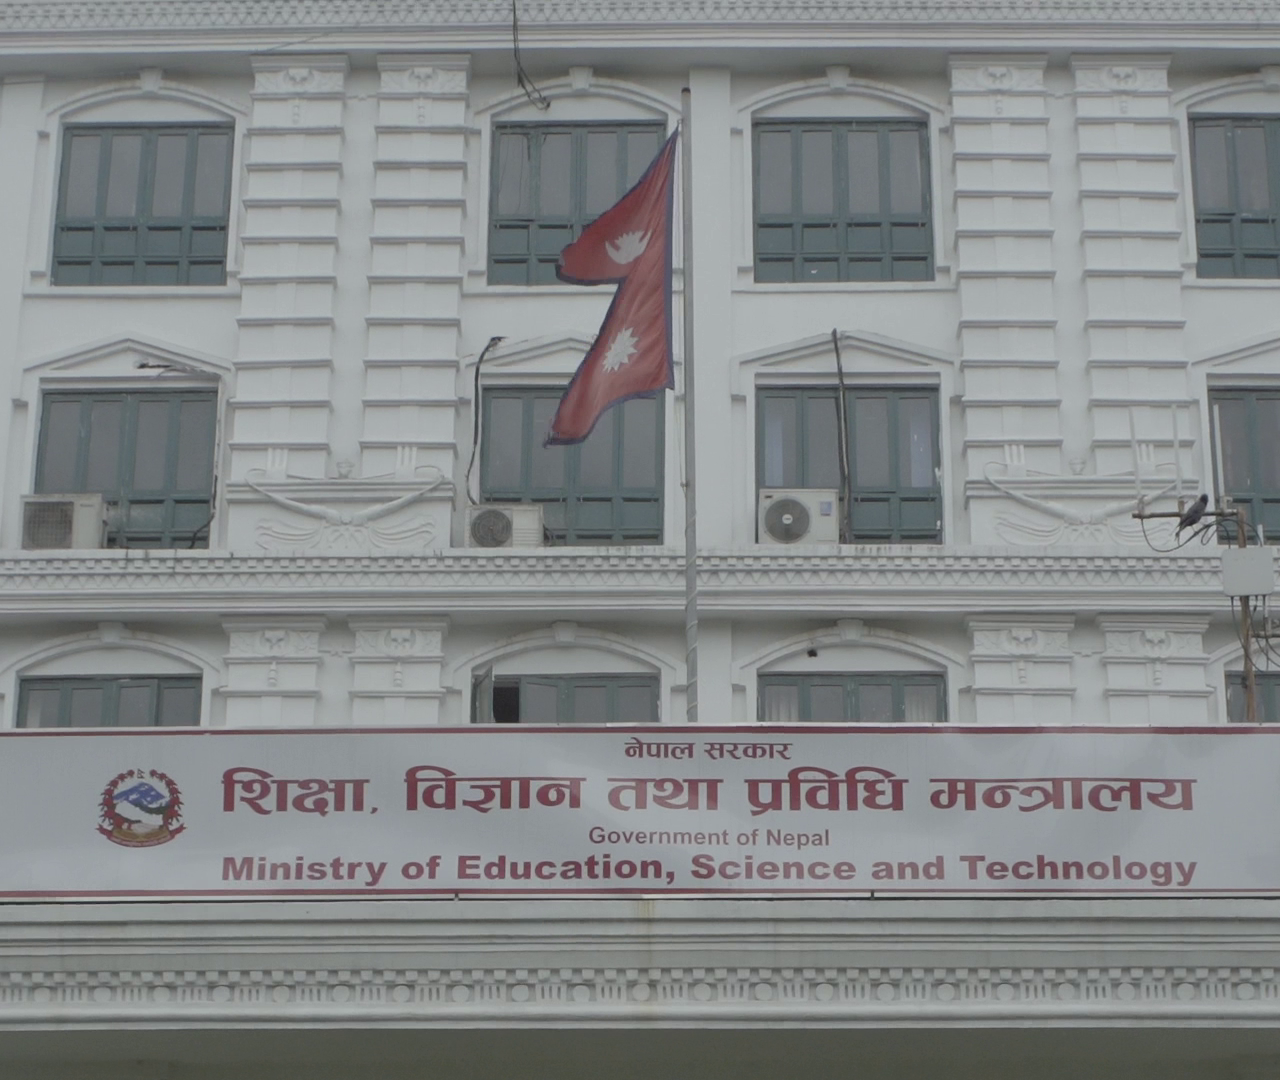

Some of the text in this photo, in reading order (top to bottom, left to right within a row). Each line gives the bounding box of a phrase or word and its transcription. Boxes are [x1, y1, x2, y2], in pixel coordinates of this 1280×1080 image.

[624, 737, 793, 761] नेपाल सरकार
[221, 765, 1198, 817] शिक्षा, विज्ञान तथा प्रविधि मन्त्रालय
[589, 827, 830, 850] Government of Nepal
[221, 854, 1198, 887] Ministry of Education, Science and Technology
